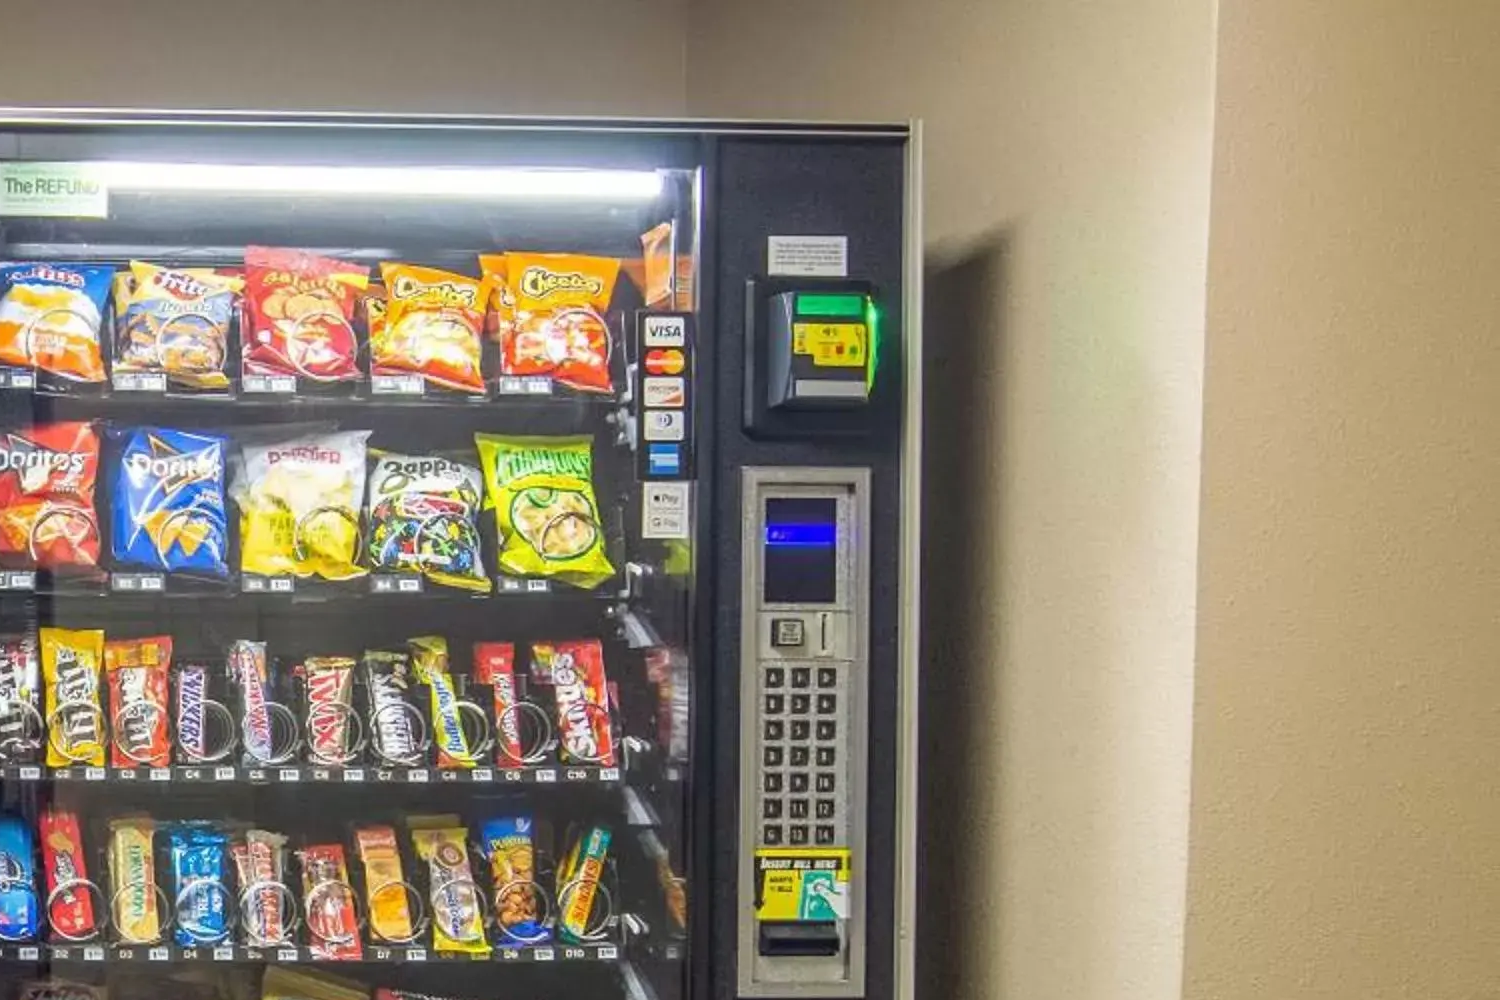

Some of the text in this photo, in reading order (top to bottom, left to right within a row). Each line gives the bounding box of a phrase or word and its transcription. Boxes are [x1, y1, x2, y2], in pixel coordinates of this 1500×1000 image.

[4, 178, 33, 194] The
[649, 325, 682, 338] VISA
[306, 667, 348, 750] TWIX
